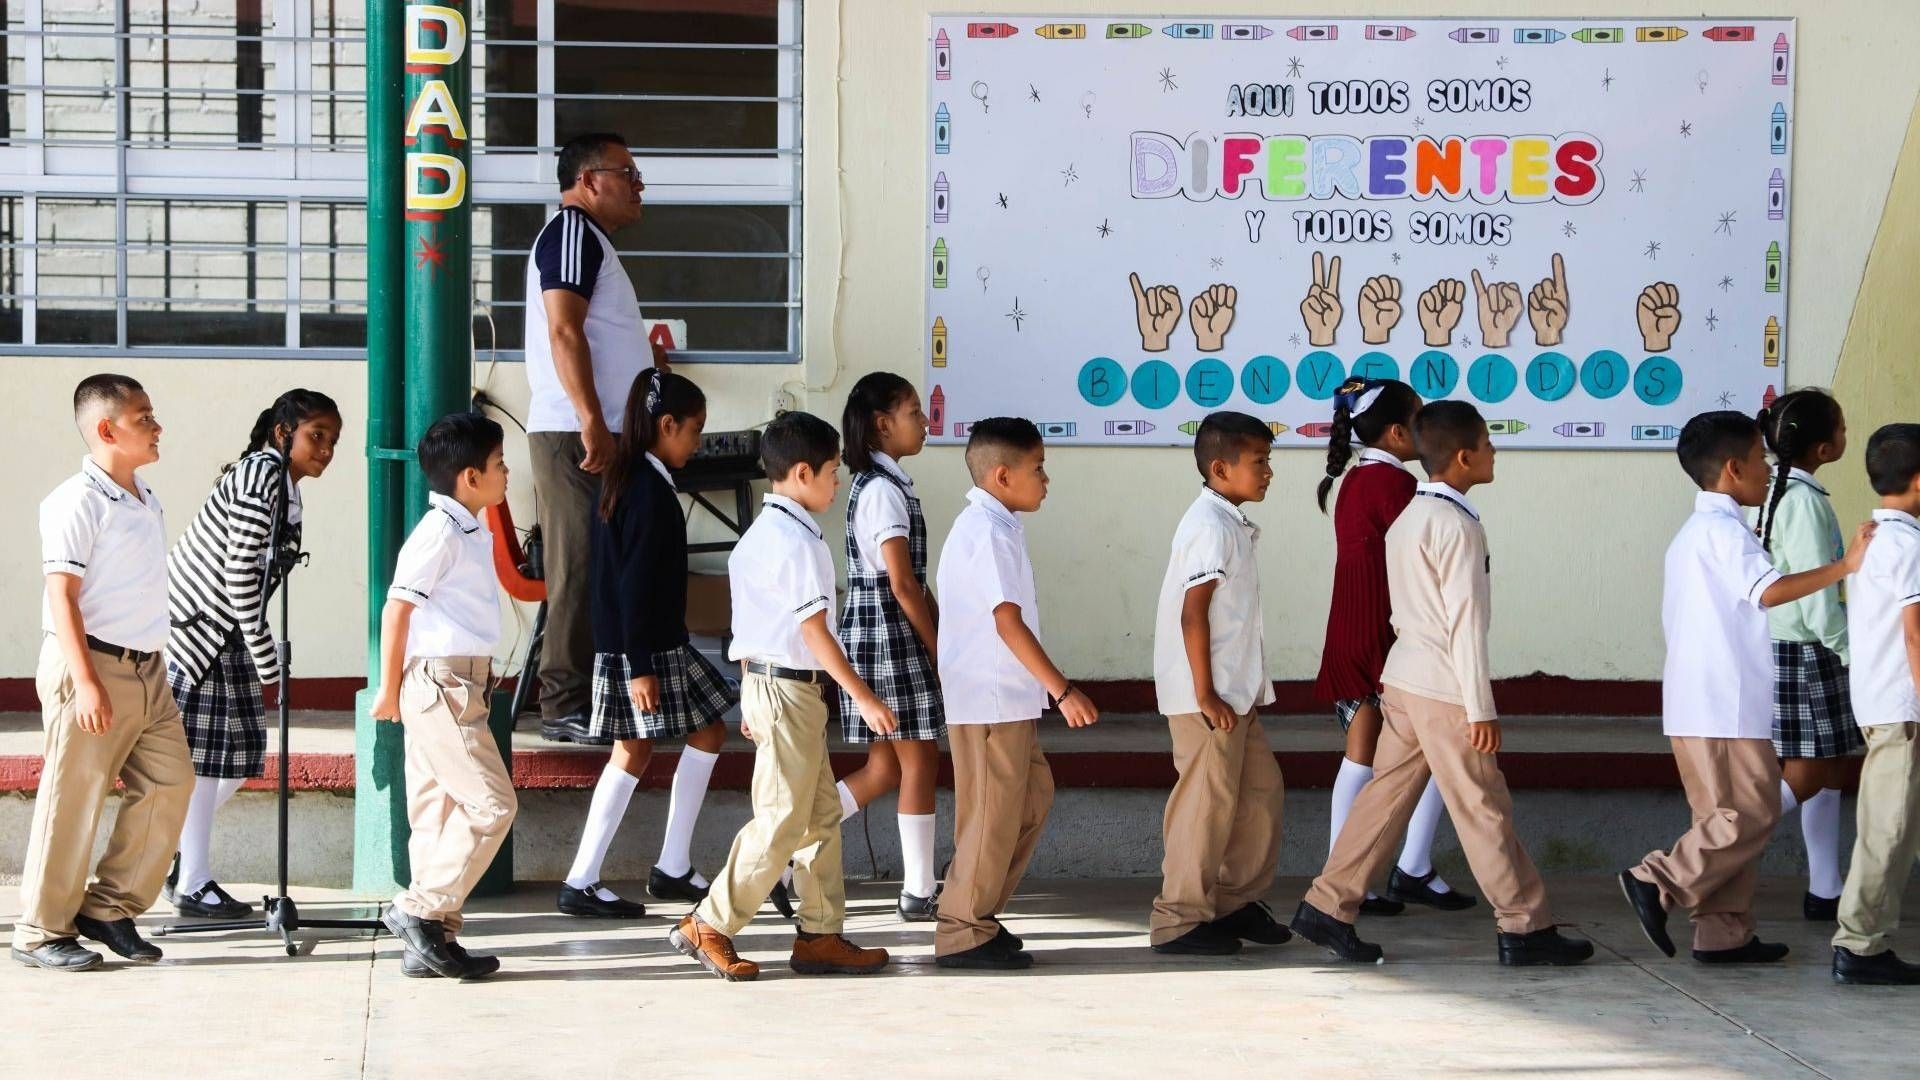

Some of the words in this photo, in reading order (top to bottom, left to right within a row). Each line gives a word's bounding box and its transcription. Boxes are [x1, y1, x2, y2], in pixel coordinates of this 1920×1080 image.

[405, 5, 467, 210] DAD
[1225, 84, 1294, 117] AQUI
[1308, 79, 1409, 115] TODOS
[1427, 78, 1531, 113] SOMOS
[1130, 132, 1604, 204] DIFERENTES
[1245, 210, 1265, 243] Y
[1293, 210, 1392, 244] TODOS
[1409, 211, 1512, 247] SOMOS
